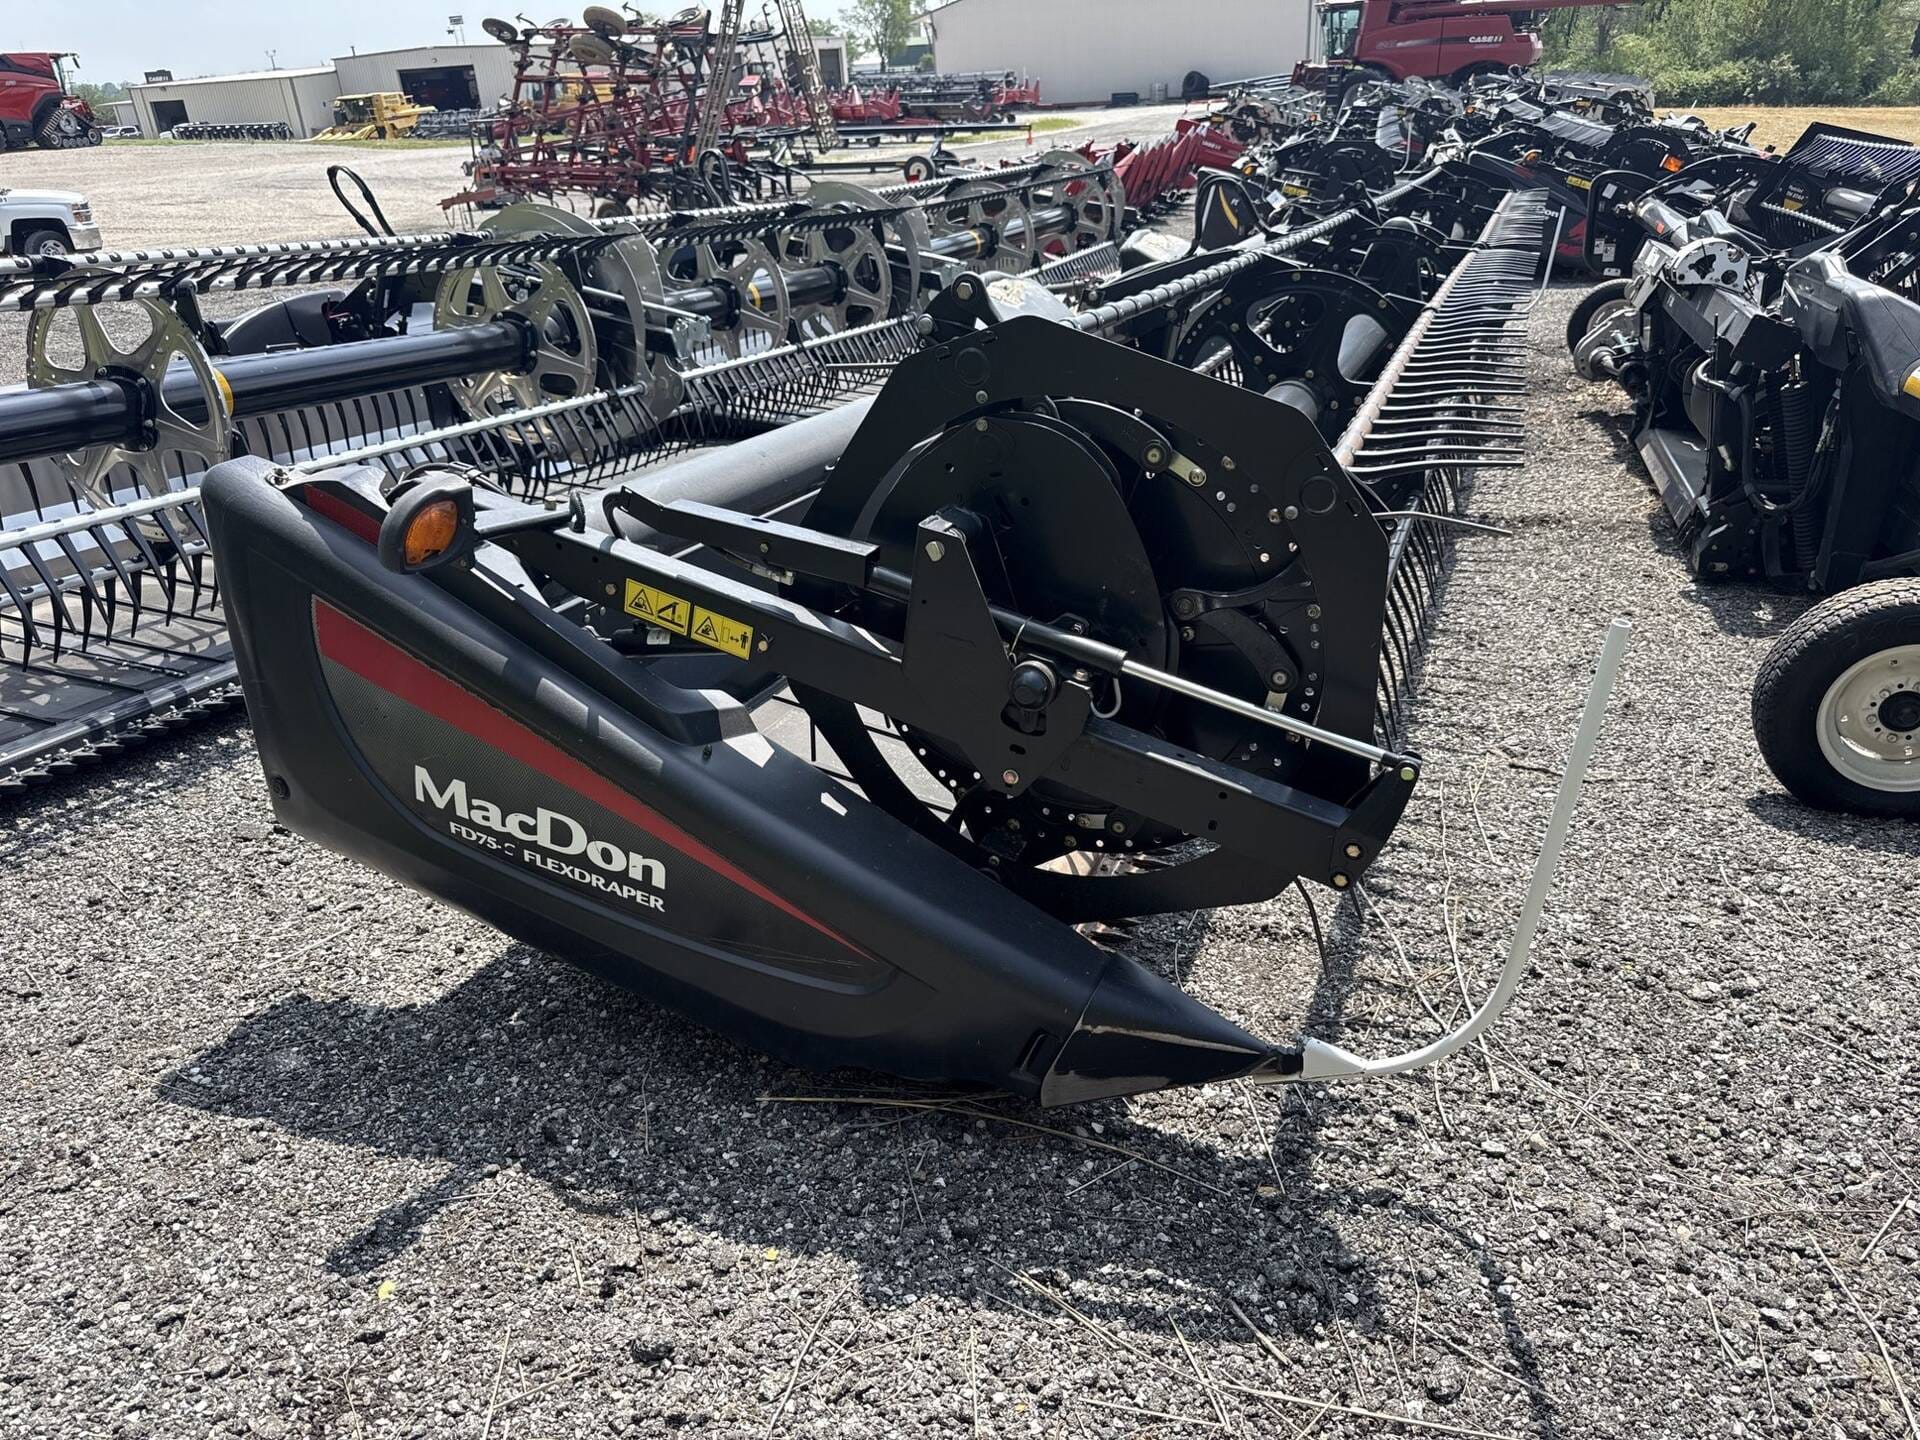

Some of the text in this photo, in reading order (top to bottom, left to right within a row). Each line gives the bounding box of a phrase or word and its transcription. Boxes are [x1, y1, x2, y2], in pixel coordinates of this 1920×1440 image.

[1468, 35, 1493, 43] CASE
[415, 765, 666, 890] MacDon
[523, 849, 666, 912] FLEXDRAPER
